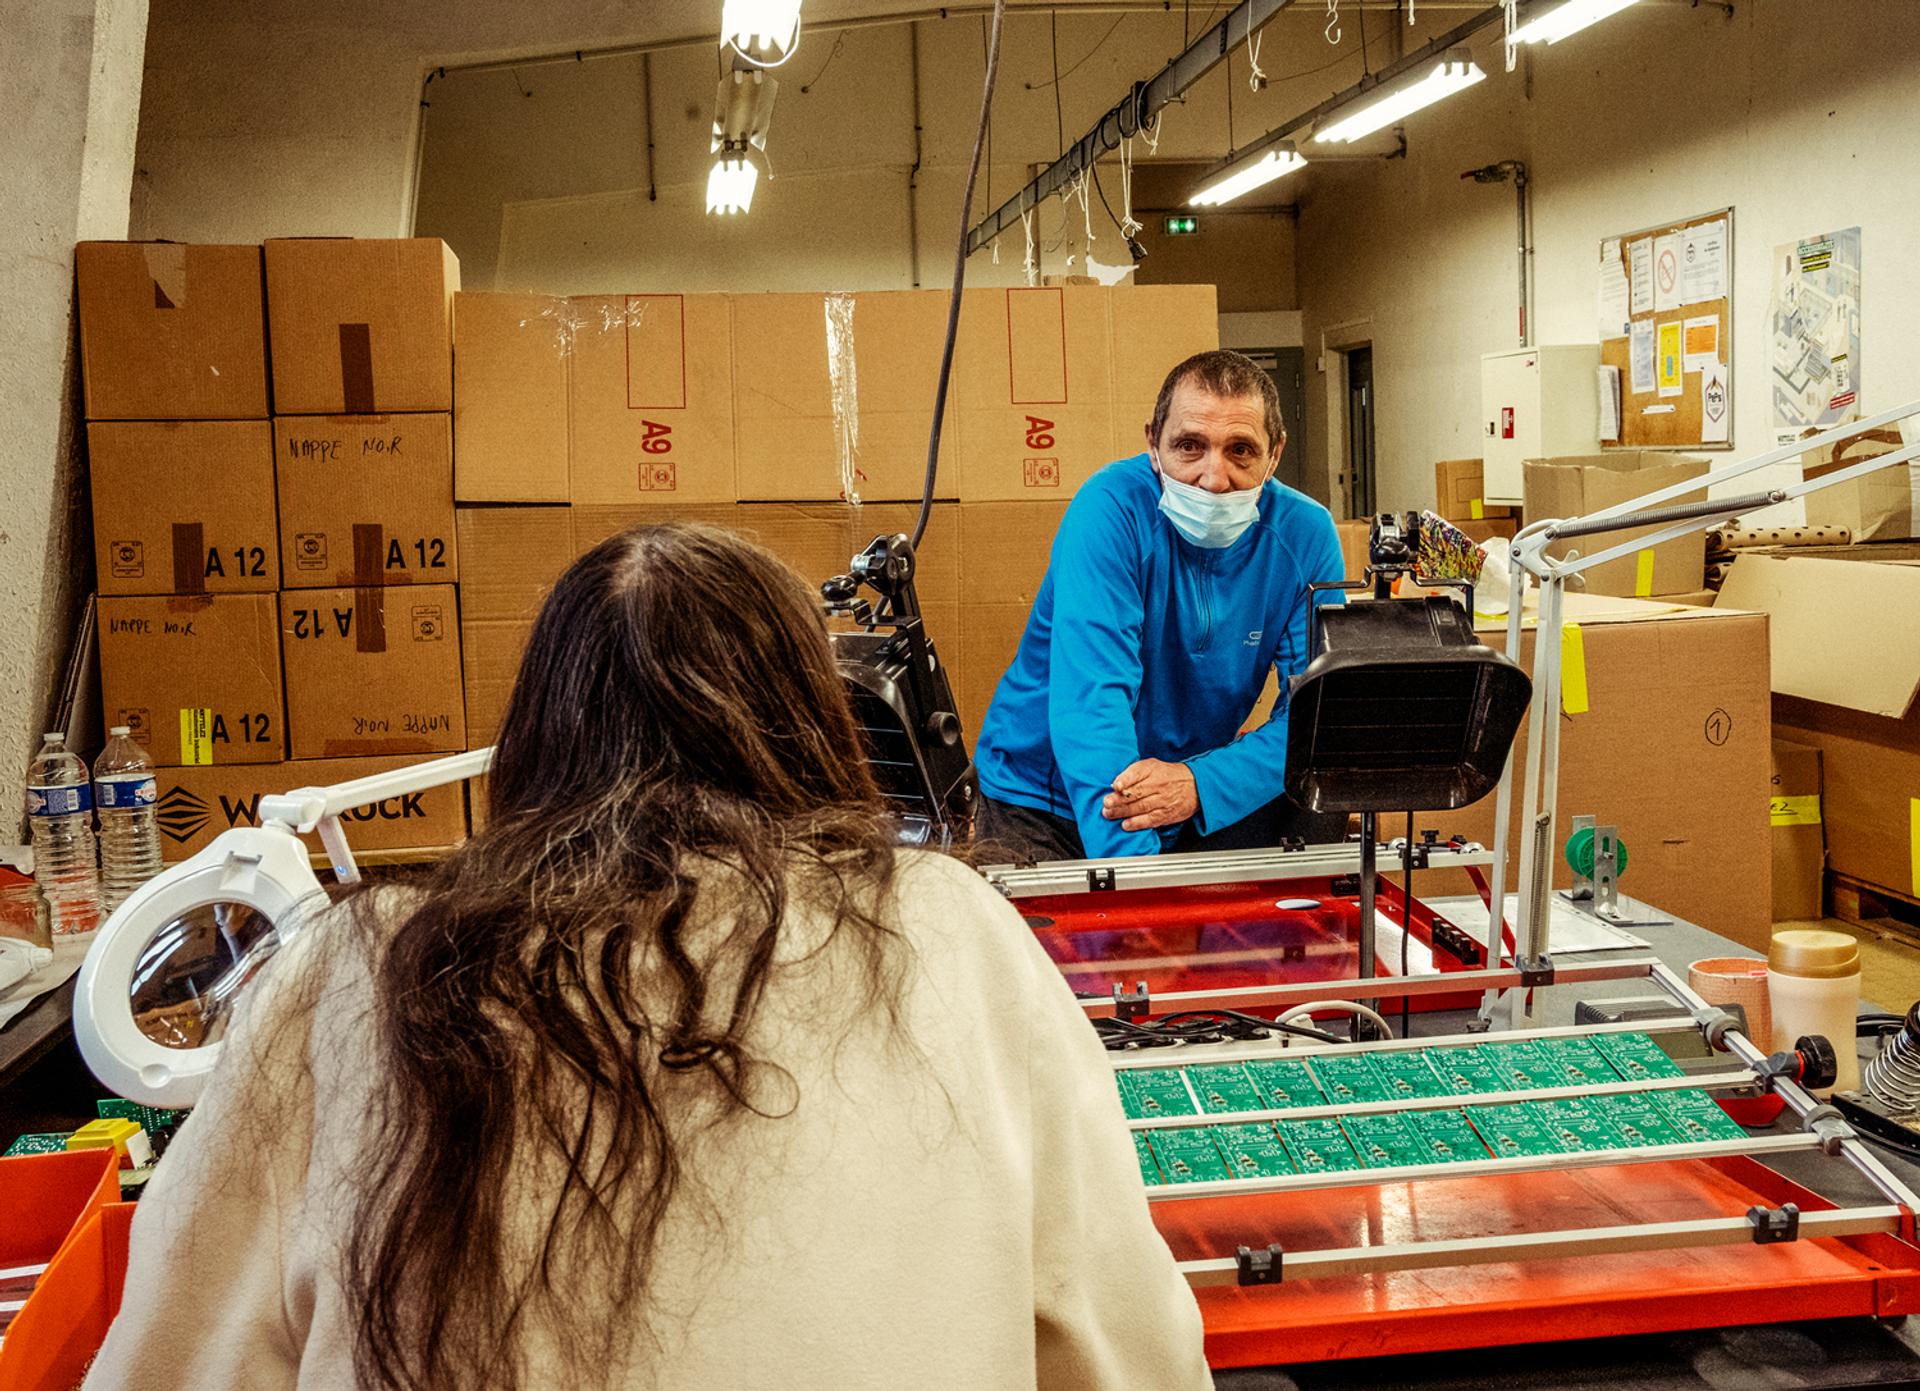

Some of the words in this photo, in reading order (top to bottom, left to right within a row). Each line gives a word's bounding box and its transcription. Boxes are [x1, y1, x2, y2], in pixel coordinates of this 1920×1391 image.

[641, 420, 672, 454] A9
[1025, 415, 1055, 450] A9
[289, 438, 342, 463] NAPPE
[204, 547, 225, 577] A
[234, 546, 266, 577] 12
[385, 538, 406, 569] A
[414, 537, 446, 568] 12
[110, 618, 152, 635] NAPPE
[293, 609, 324, 639] 12
[333, 608, 353, 638] A
[211, 714, 231, 744] A
[239, 713, 271, 743] 12
